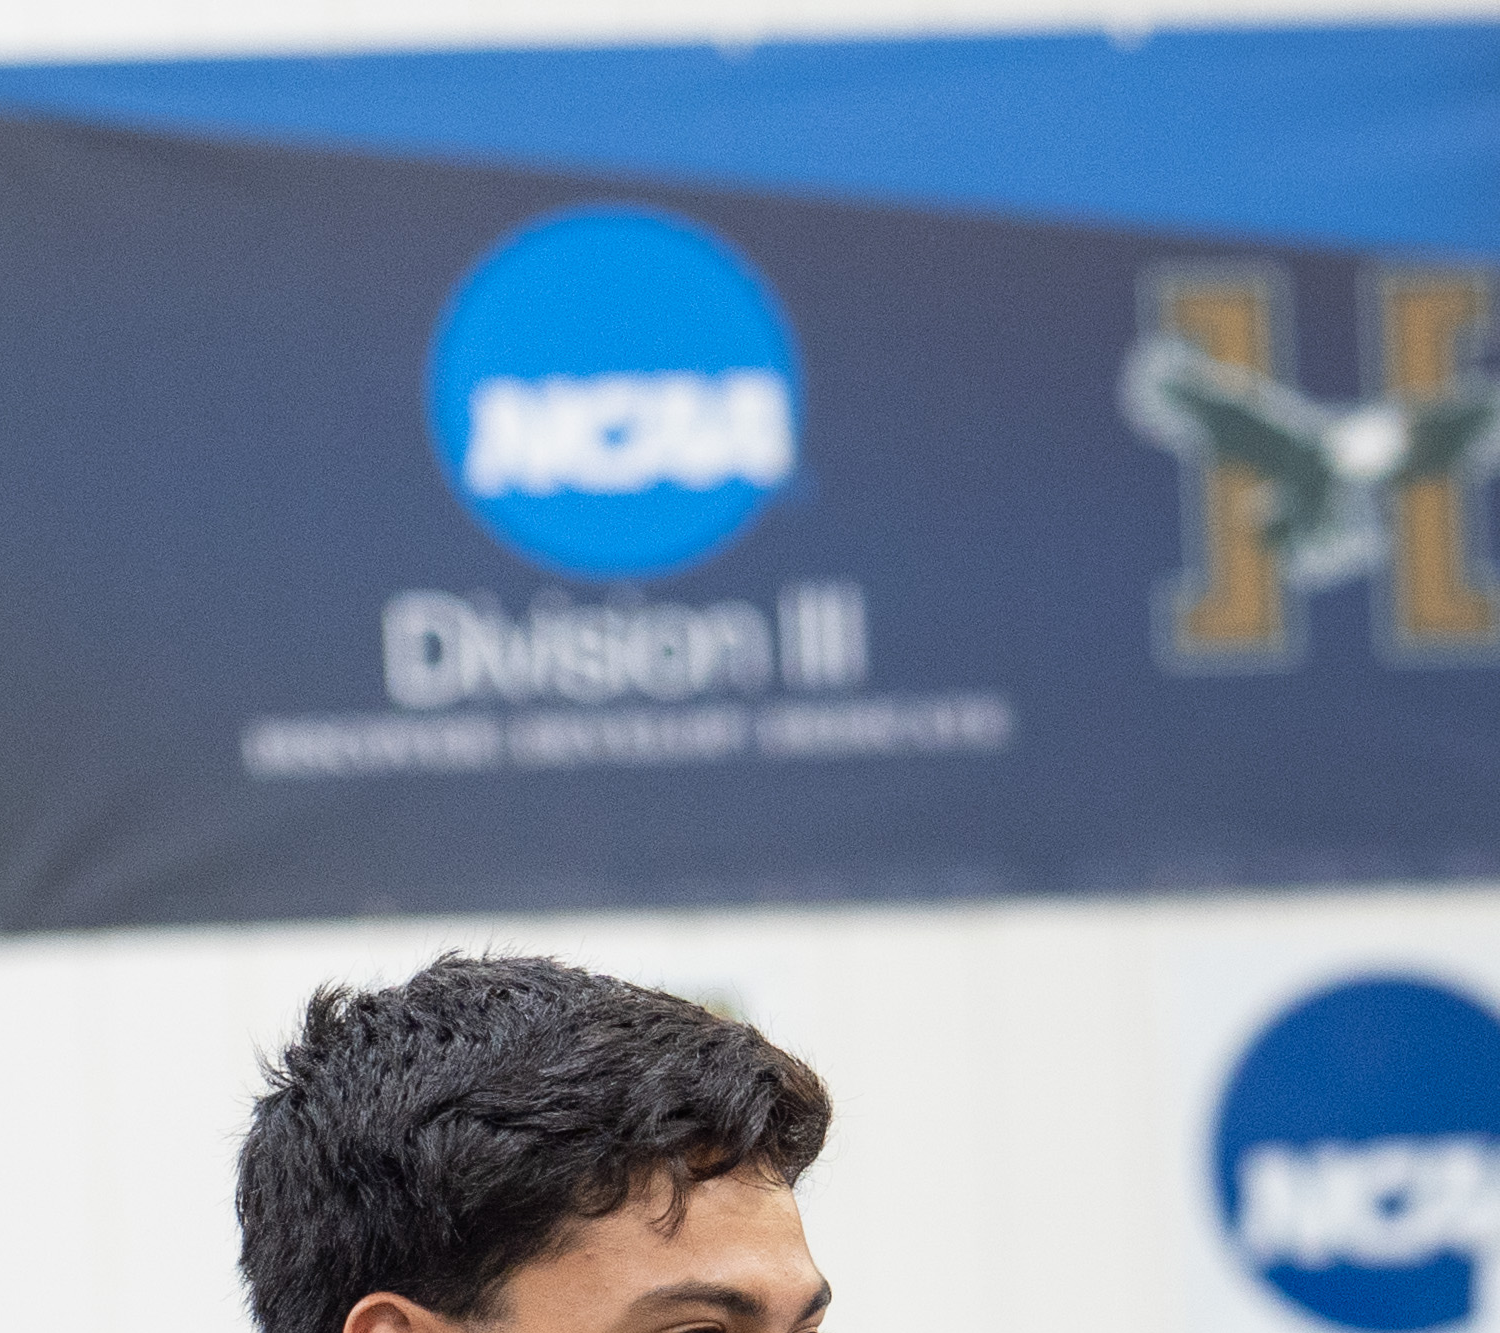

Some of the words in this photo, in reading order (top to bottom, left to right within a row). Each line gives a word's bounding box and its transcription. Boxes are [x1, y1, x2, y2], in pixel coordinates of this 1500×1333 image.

[468, 366, 796, 498] NCAA
[384, 585, 775, 710] Division
[780, 582, 868, 686] III
